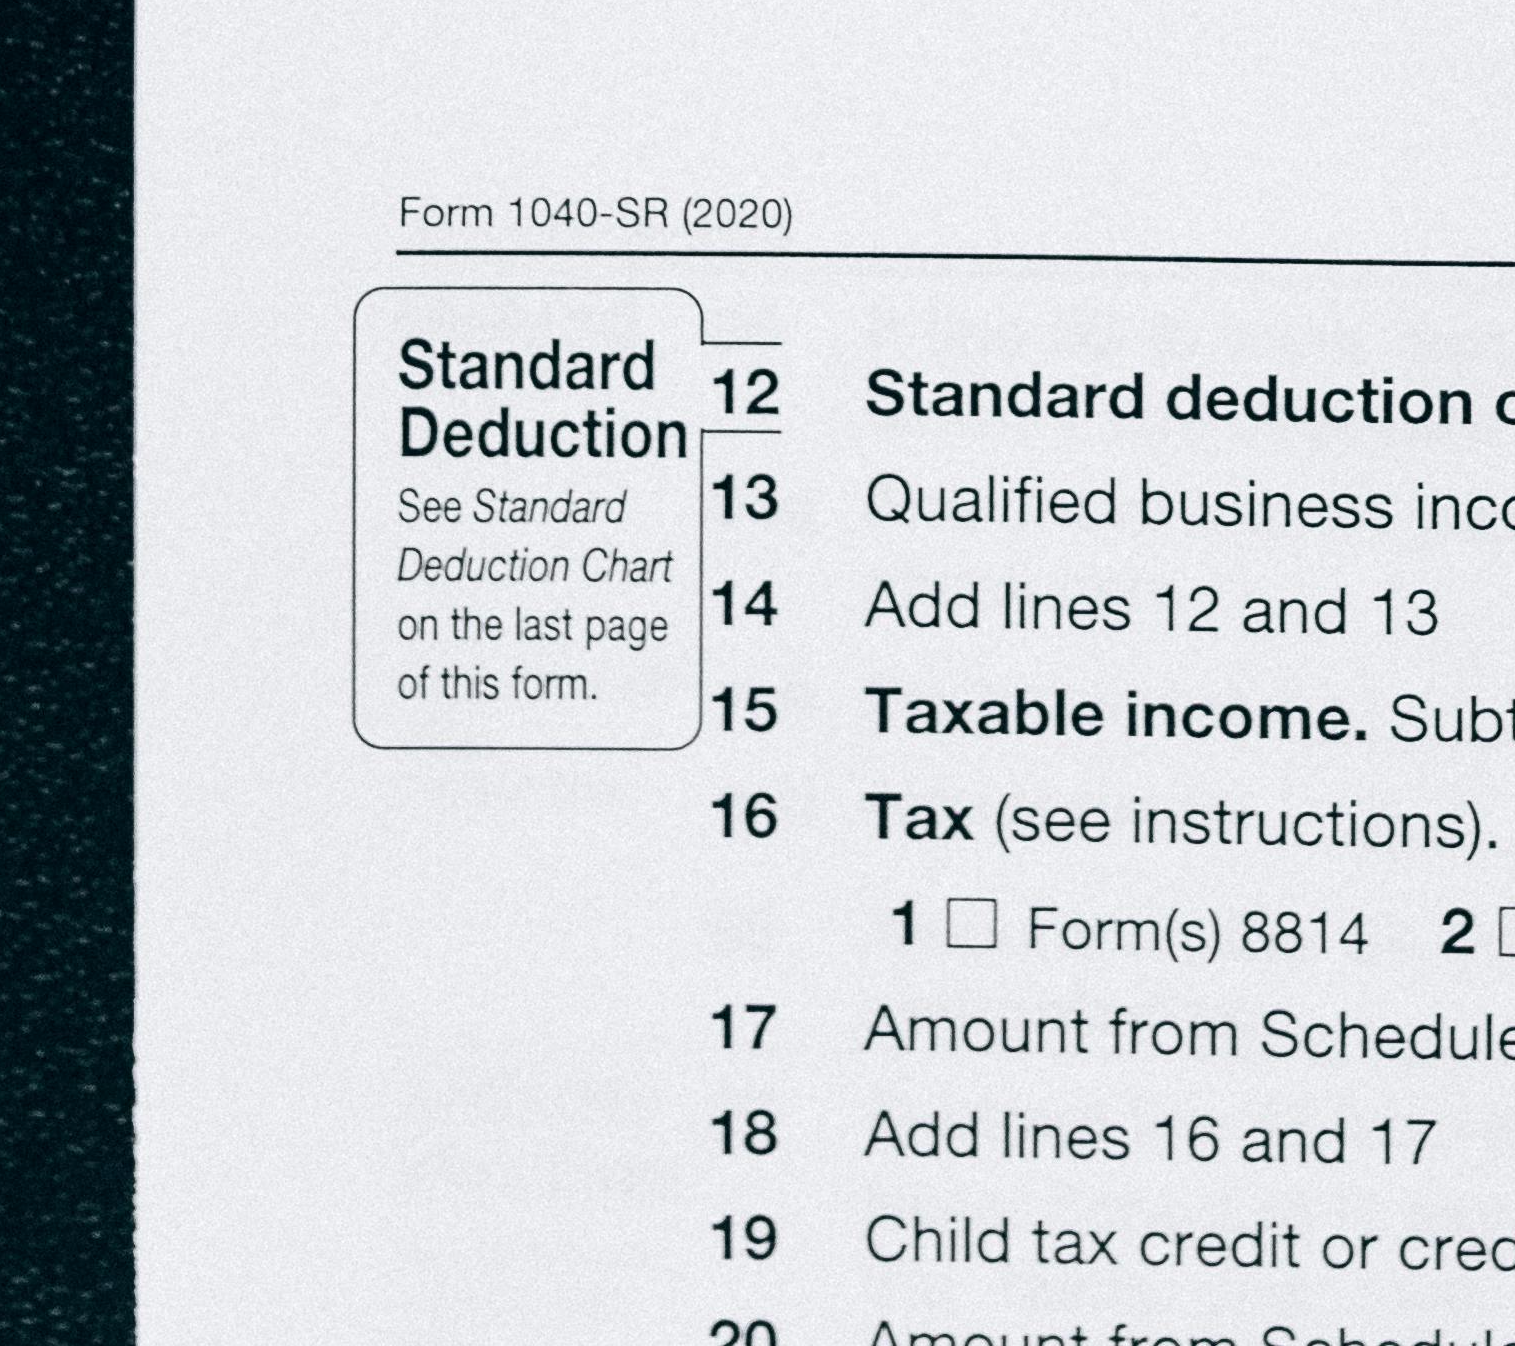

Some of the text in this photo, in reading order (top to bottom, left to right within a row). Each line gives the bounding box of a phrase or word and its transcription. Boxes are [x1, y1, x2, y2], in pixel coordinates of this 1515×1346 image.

[397, 195, 793, 238] Form 1040-SR (2020)
[397, 336, 656, 392] Standard
[712, 367, 781, 416] 12
[865, 367, 1145, 421] Standard
[1165, 372, 1473, 426] deduction
[400, 405, 688, 460] Deduction
[397, 486, 629, 525] See Standard
[711, 472, 780, 521] 13
[866, 472, 1117, 526] Qualified
[1140, 476, 1395, 531] business
[396, 545, 675, 584] Deduction Chart
[397, 605, 669, 653] on the last page
[711, 578, 1440, 638] 14 Add lines 12 and 13
[397, 663, 599, 701] of this form.
[710, 685, 779, 734] 15
[863, 685, 1105, 738] Taxable
[1126, 688, 1368, 742] income.
[711, 791, 779, 840] 16
[863, 791, 975, 842] Tax
[995, 791, 1112, 855] (see
[1133, 794, 1498, 863] instructions).
[891, 898, 915, 947] 1
[1029, 905, 1221, 965] Form(s)
[1241, 909, 1370, 956] 8814
[1439, 906, 1476, 956] 2
[710, 1002, 778, 1051] 17
[862, 1003, 1090, 1055] Amount
[1107, 1005, 1238, 1058] from
[710, 1108, 1438, 1166] 18 Add lines 16 and 17
[711, 1213, 778, 1262] 19
[865, 1213, 1010, 1265] Child
[1030, 1219, 1119, 1266] tax
[1139, 1219, 1302, 1269] credit
[1321, 1233, 1380, 1271] or
